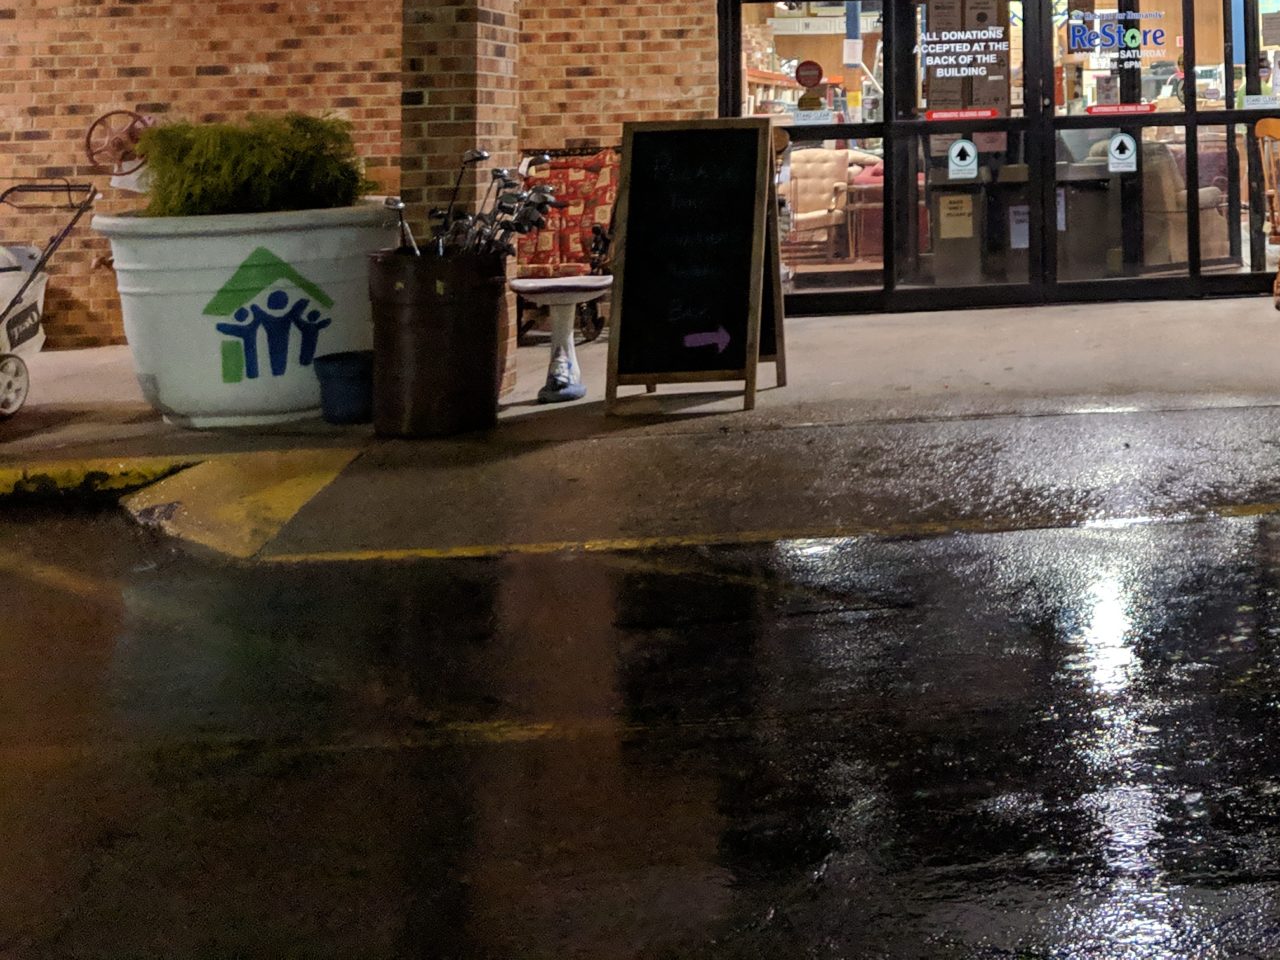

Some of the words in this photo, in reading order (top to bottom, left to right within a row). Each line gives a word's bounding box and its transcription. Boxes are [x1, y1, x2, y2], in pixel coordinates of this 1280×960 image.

[920, 31, 940, 42] ALL
[942, 30, 1003, 41] DONATIONS
[1070, 23, 1165, 49] ReStore
[913, 42, 971, 54] ACCEPTED
[972, 42, 986, 52] AT
[988, 41, 1009, 51] THE
[1119, 48, 1167, 59] SATURDAY
[926, 55, 957, 66] BACK
[959, 54, 974, 64] OF
[975, 54, 997, 64] THE
[1124, 60, 1142, 70] 6PM
[936, 66, 987, 78] BUILDING
